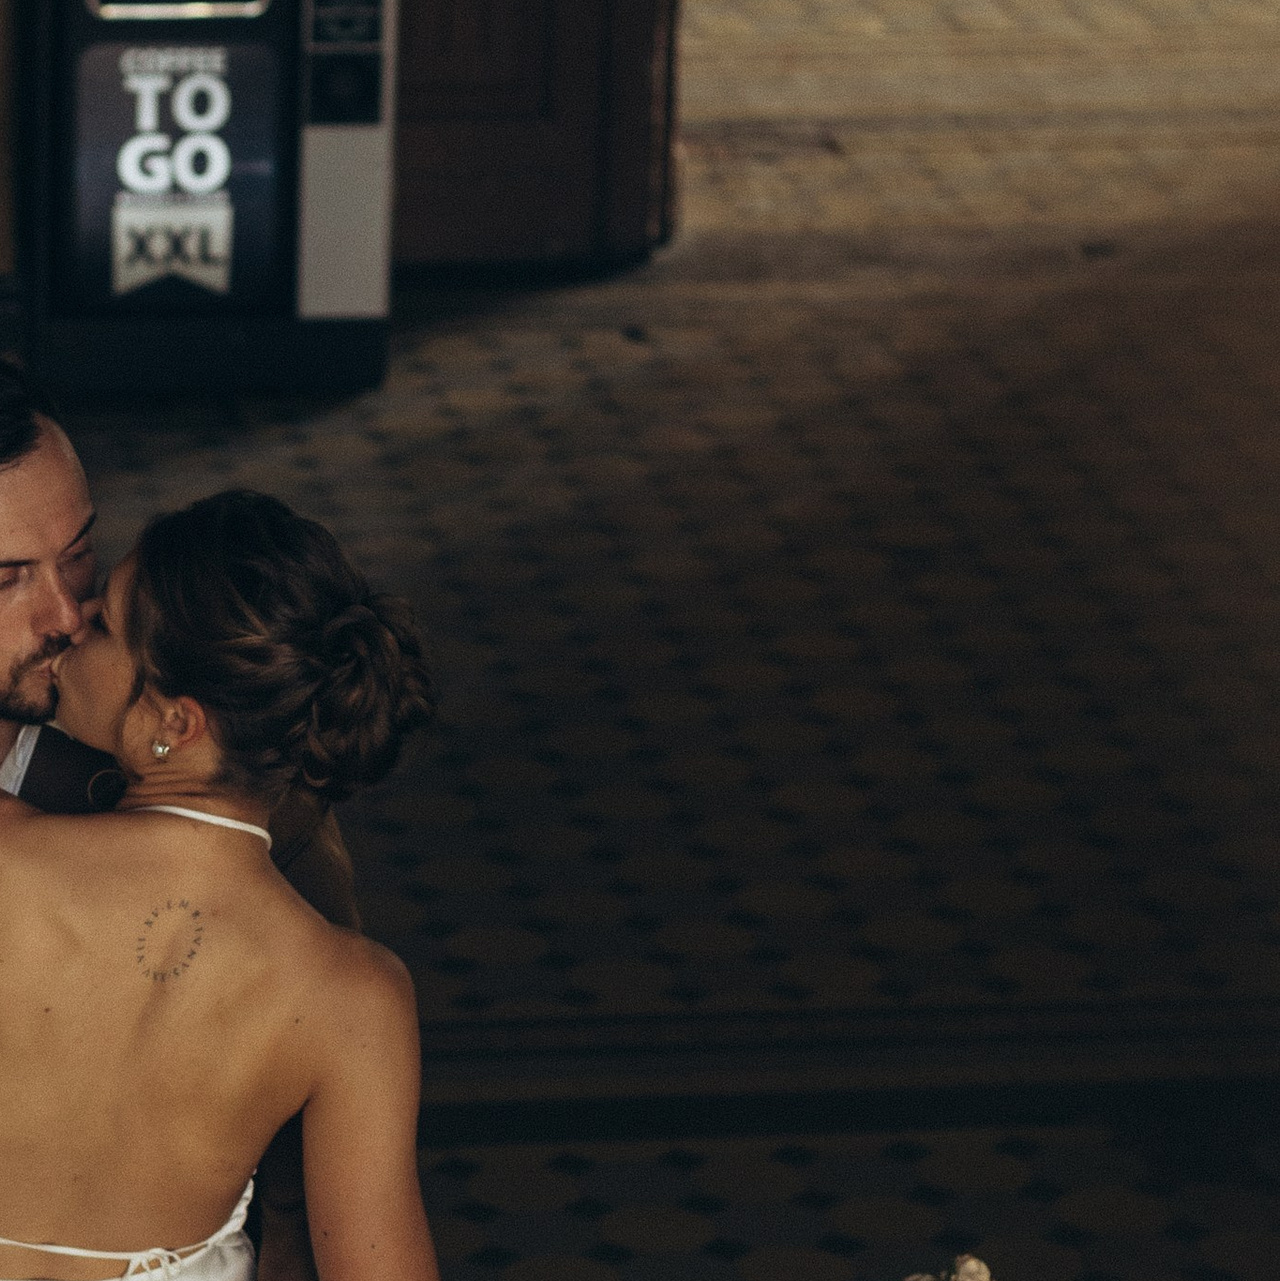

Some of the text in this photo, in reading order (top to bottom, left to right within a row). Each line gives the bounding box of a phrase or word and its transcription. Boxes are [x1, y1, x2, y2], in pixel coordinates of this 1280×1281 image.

[123, 74, 231, 132] TO
[117, 134, 231, 193] GO
[127, 225, 224, 264] XXL
